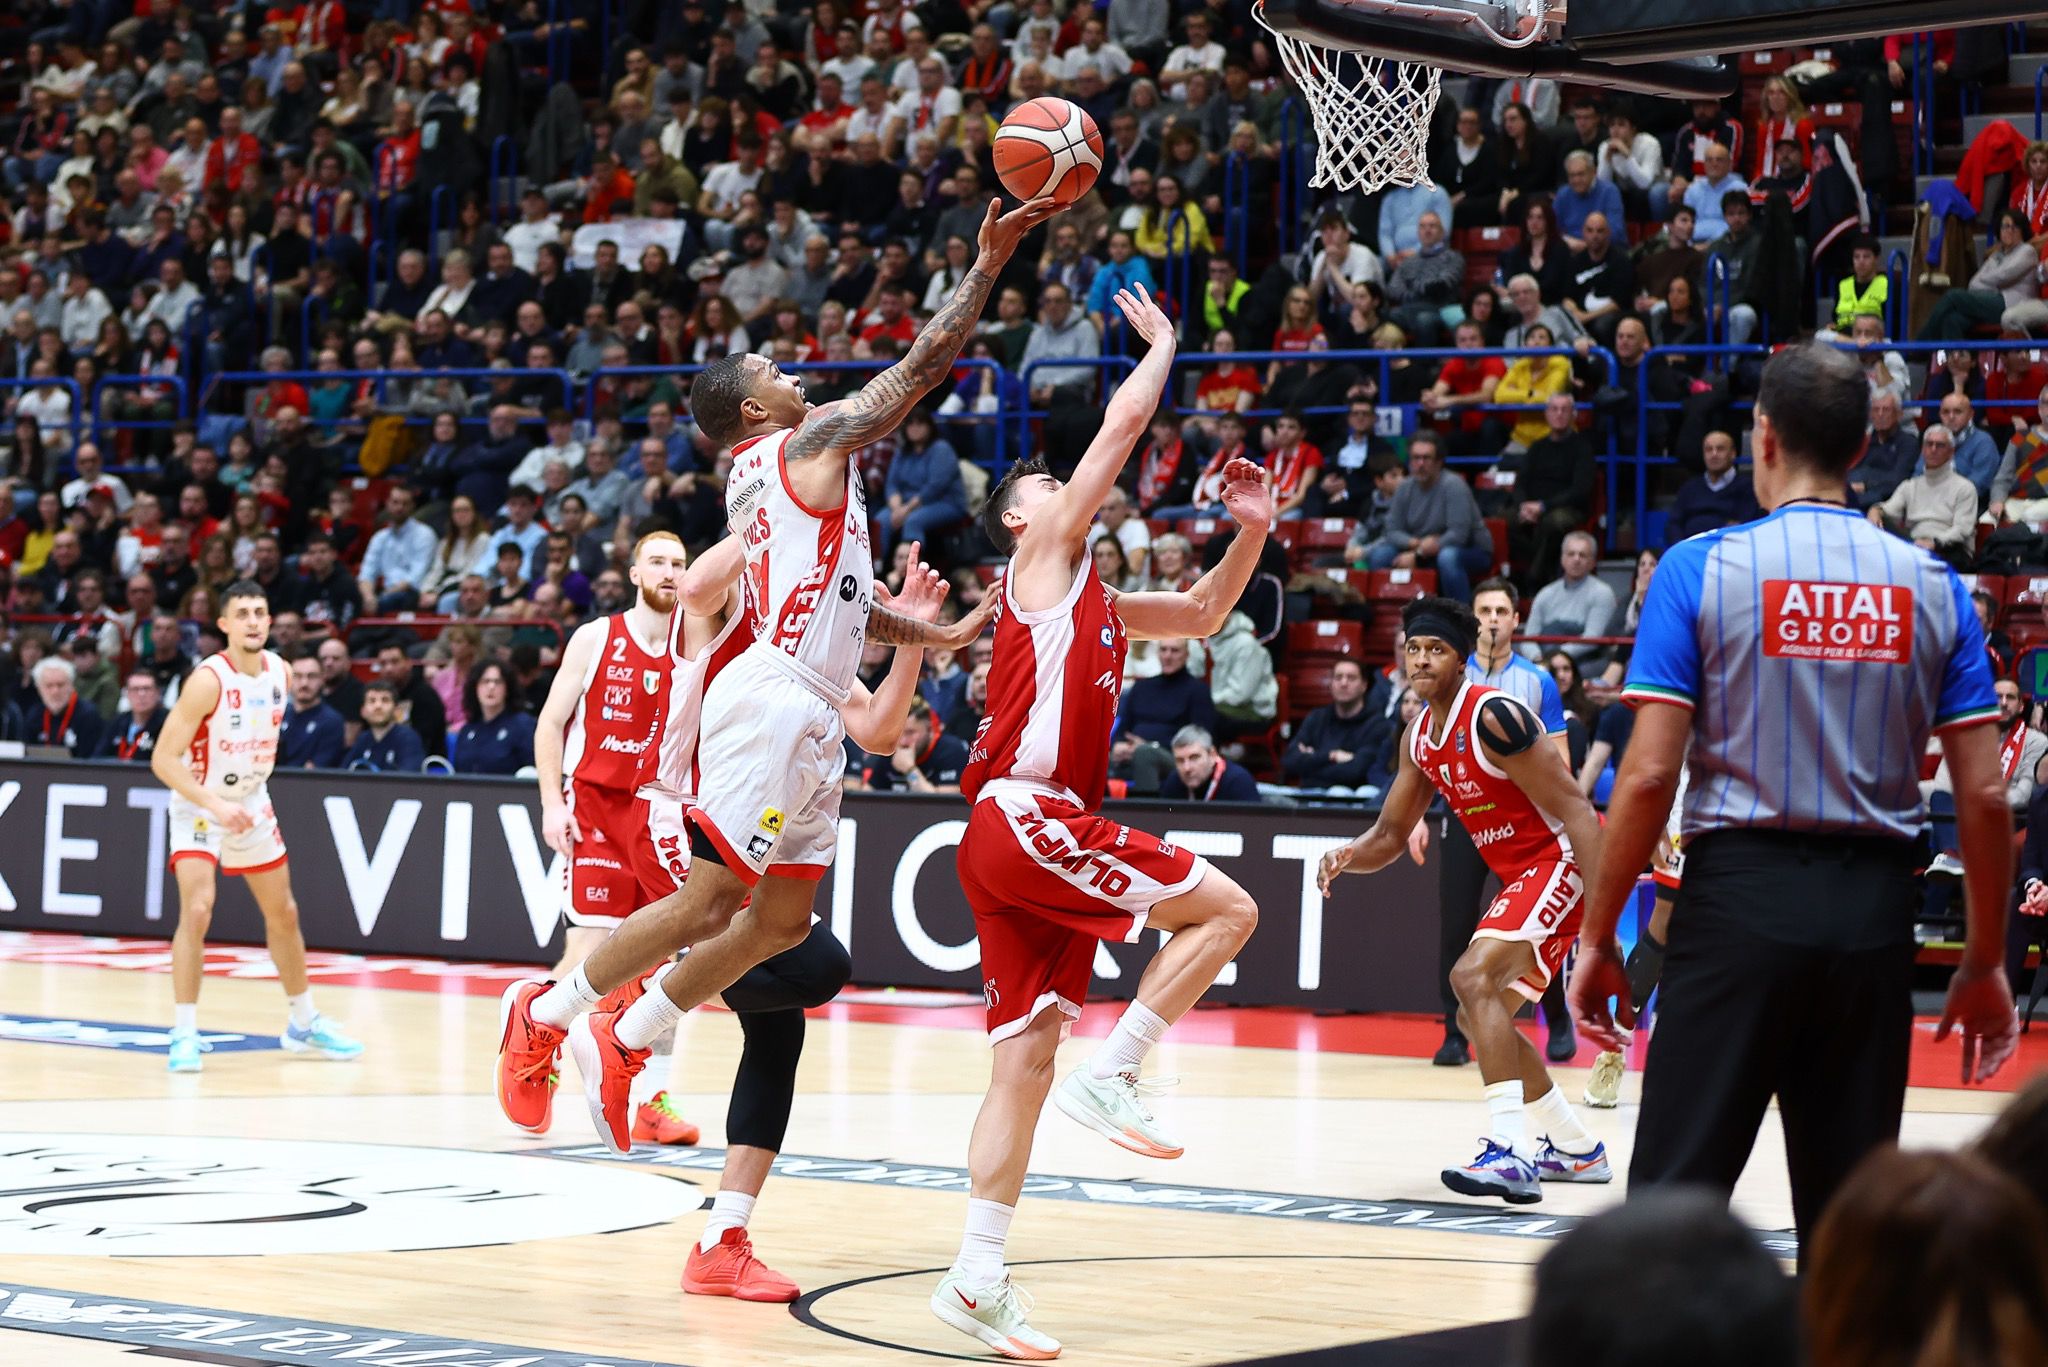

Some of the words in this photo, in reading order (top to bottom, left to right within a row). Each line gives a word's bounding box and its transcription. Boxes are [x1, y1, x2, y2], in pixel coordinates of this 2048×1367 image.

[1779, 582, 1900, 621] ATTAL
[1778, 619, 1901, 646] GROUP
[611, 636, 627, 662] 2
[226, 689, 242, 709] 13
[600, 734, 644, 755] Media
[761, 821, 780, 833] TIGROS
